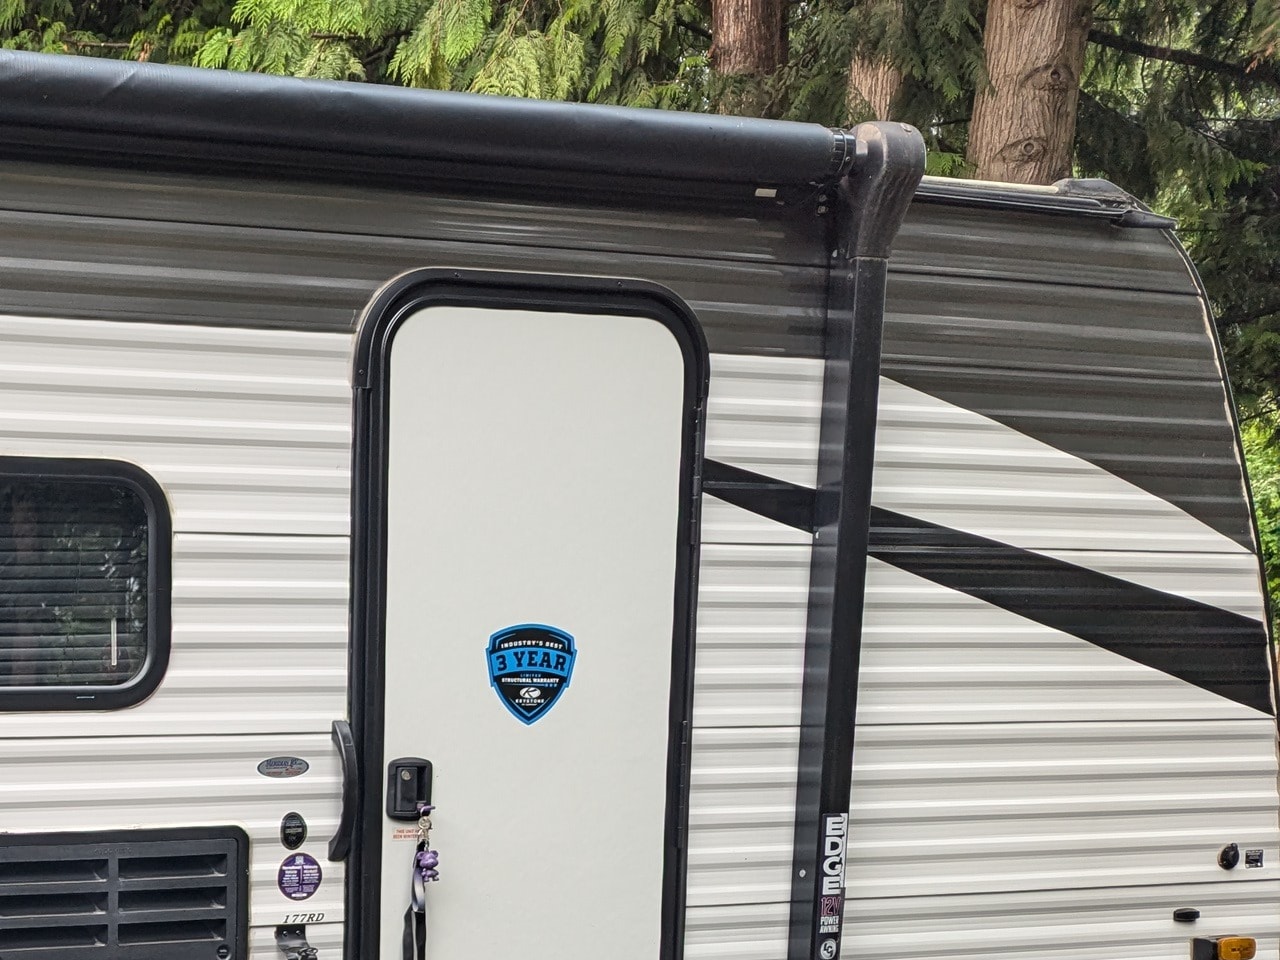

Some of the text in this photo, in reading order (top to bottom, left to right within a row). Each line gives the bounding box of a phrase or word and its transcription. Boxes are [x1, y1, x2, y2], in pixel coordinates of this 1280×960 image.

[501, 640, 543, 649] INDUSTRY'S
[496, 651, 567, 672] 3 YEAR
[822, 816, 846, 895] EDGE
[821, 897, 841, 916] 12V
[283, 912, 325, 924] 177RD
[820, 915, 839, 926] POWER
[819, 925, 839, 934] AWNING
